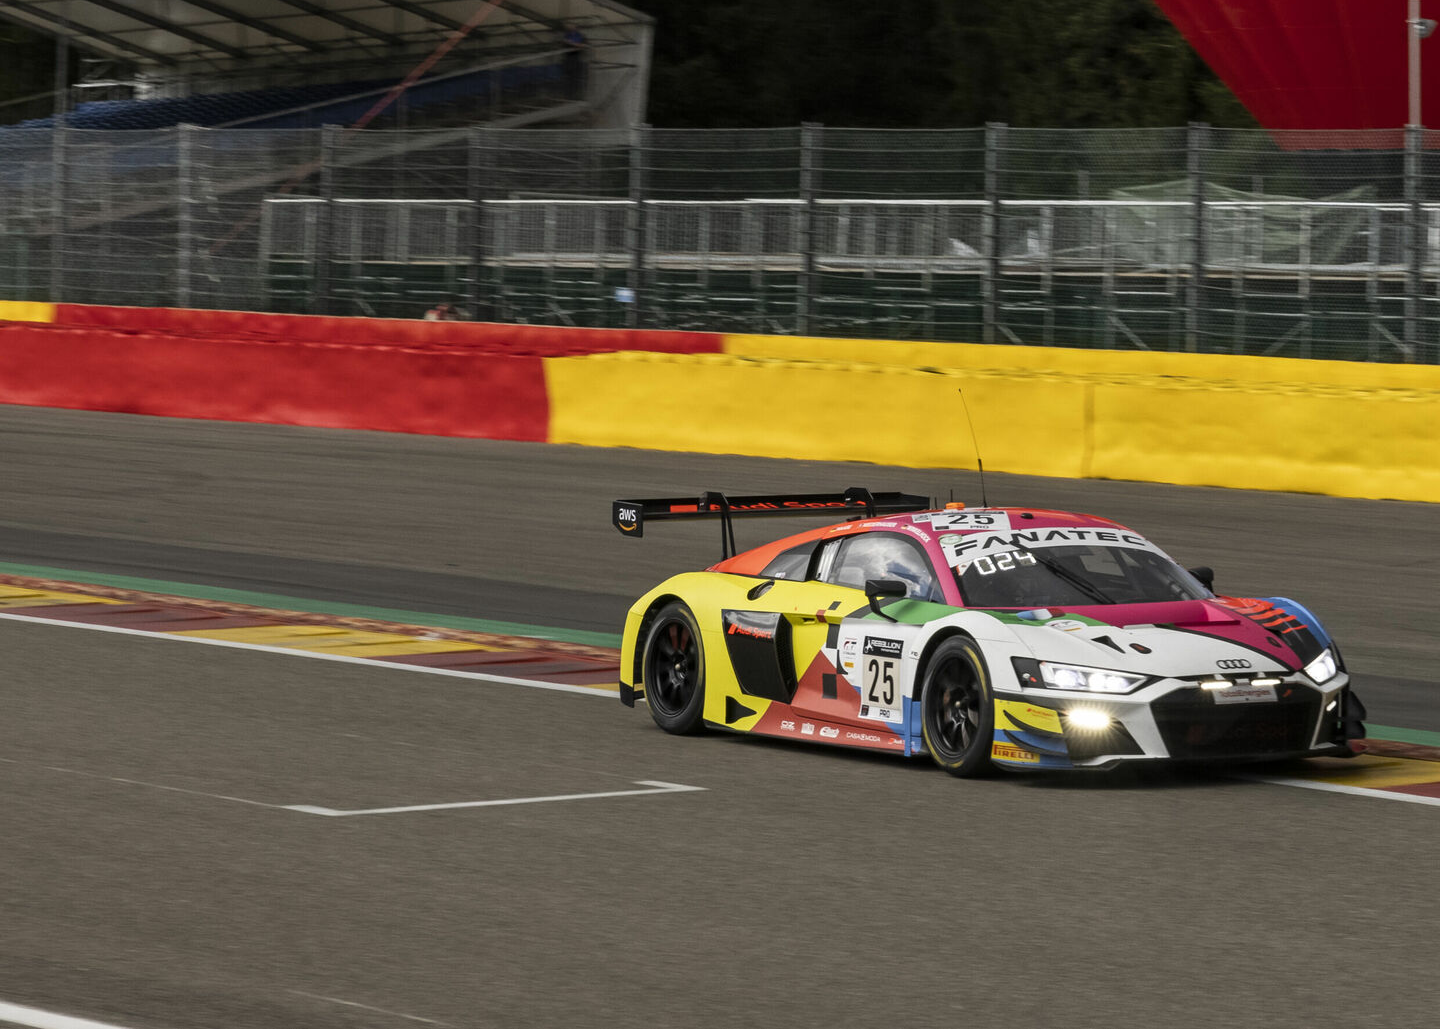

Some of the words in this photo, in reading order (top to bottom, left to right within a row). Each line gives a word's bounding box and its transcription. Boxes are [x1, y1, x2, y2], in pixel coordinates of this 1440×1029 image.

[619, 508, 637, 522] aws
[948, 514, 995, 525] 25
[954, 530, 1146, 557] FANATEC
[973, 551, 1036, 575] 024
[736, 625, 752, 635] Audi
[752, 627, 772, 639] Sport
[871, 639, 901, 649] REBELLION
[868, 659, 894, 705] 25
[879, 709, 890, 718] PRO
[993, 744, 1035, 759] PIRELLI
